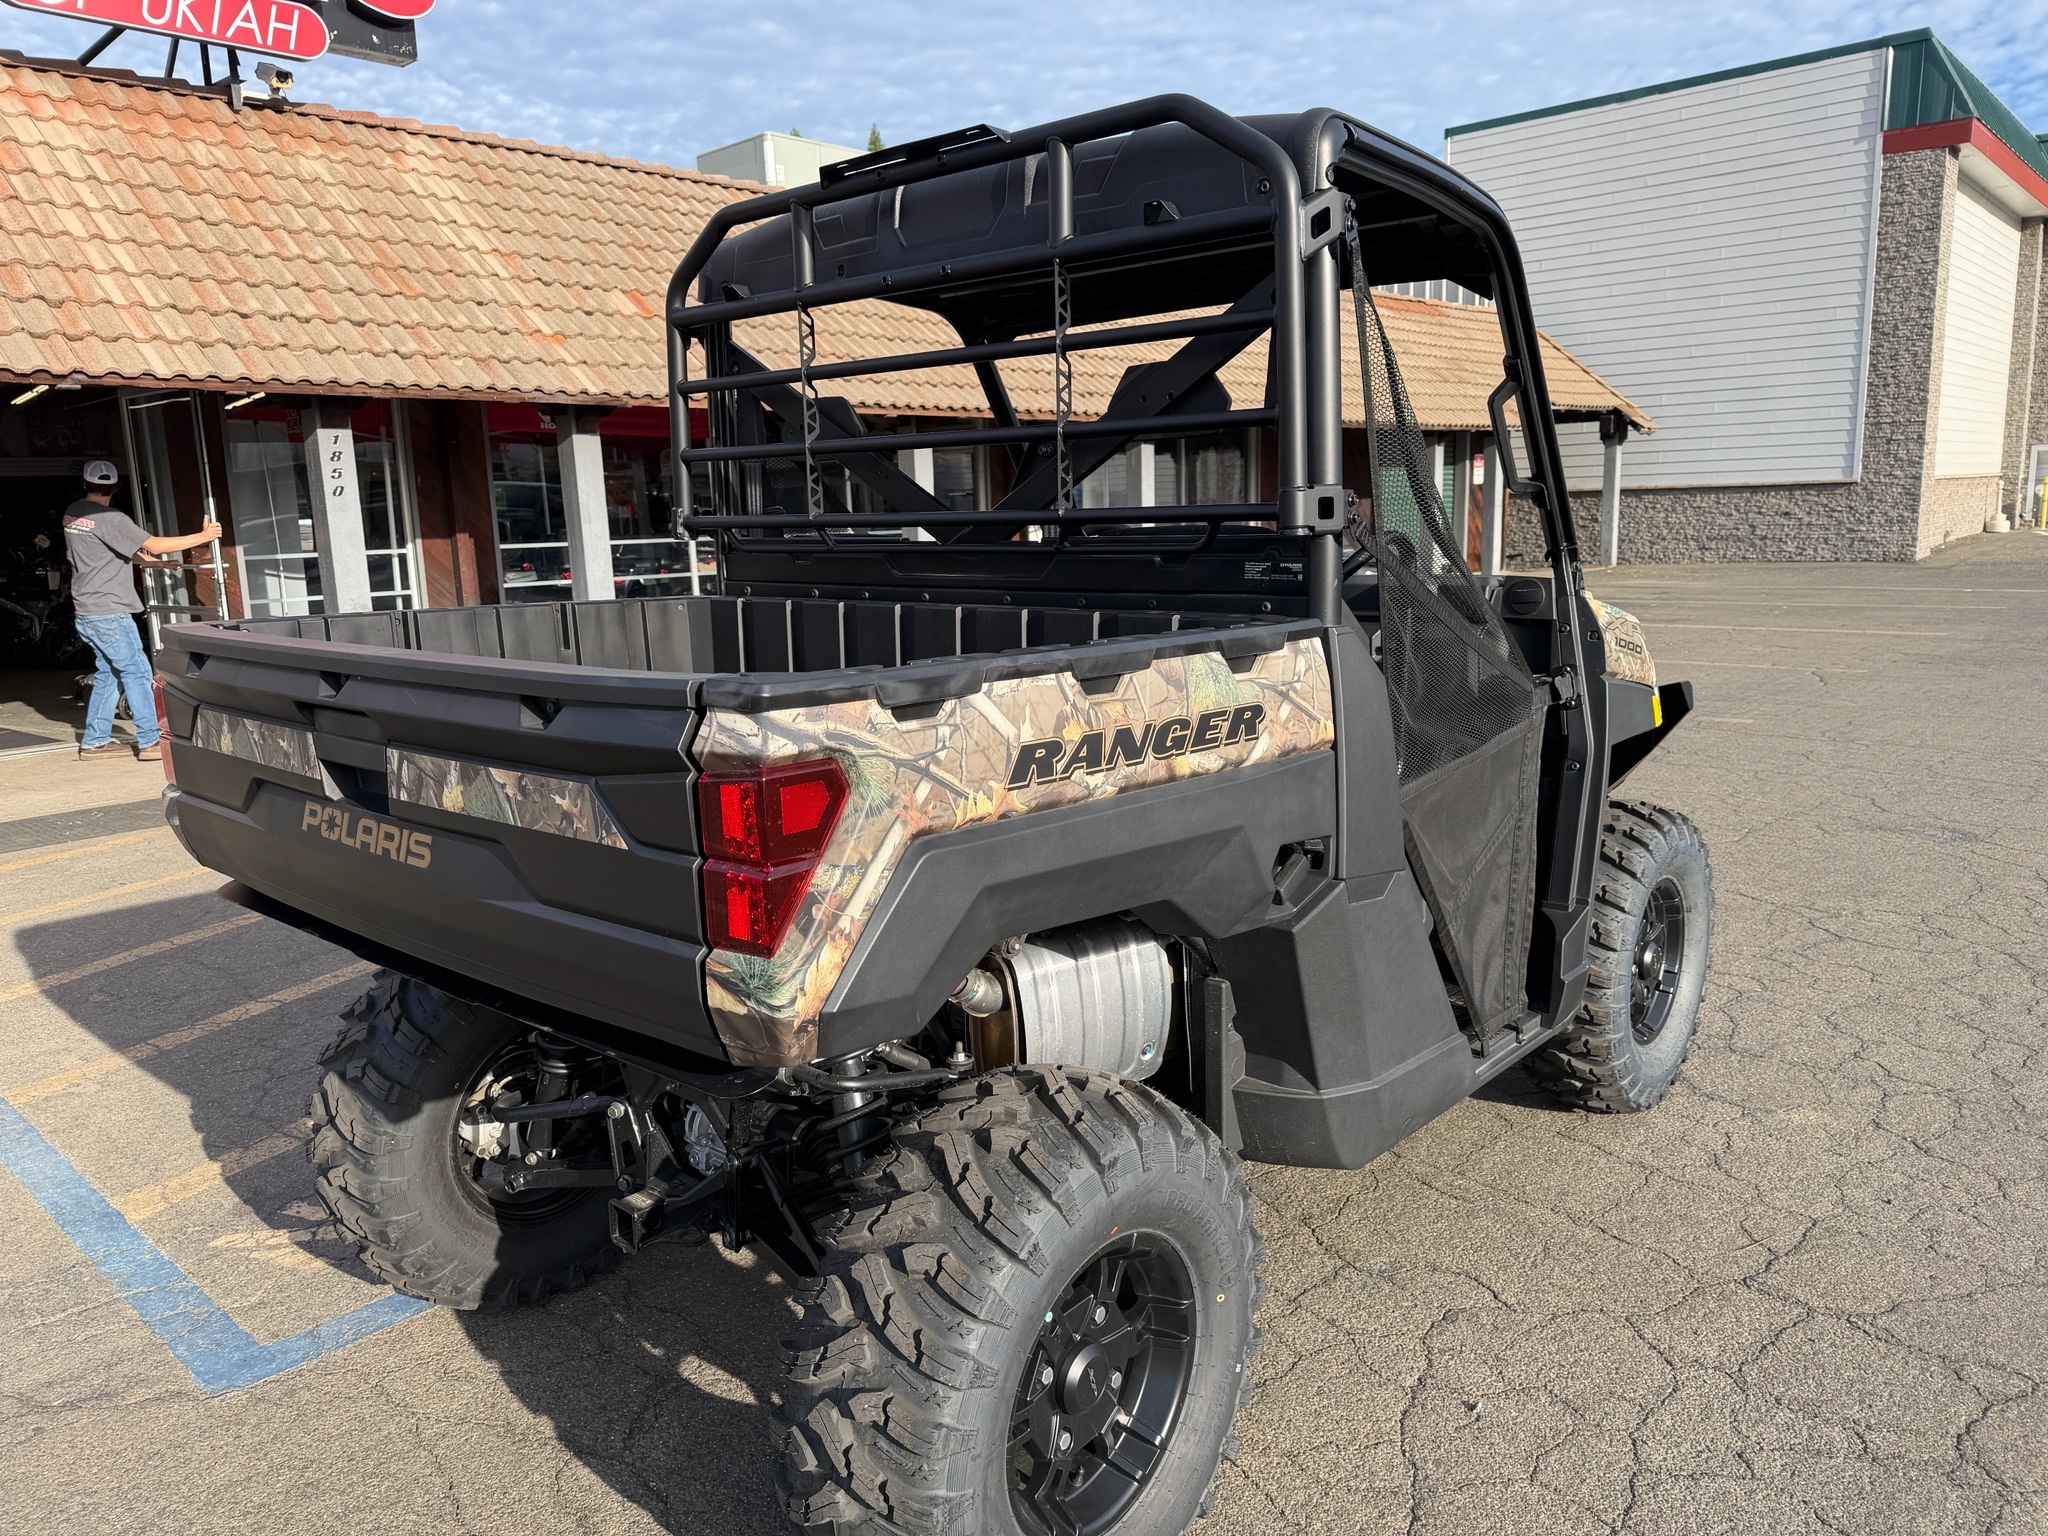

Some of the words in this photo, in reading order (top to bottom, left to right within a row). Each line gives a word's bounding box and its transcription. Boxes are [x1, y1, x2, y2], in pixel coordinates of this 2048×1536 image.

[141, 0, 300, 51] UKIAH
[329, 433, 345, 497] 1850
[1605, 610, 1642, 638] XP
[1614, 636, 1643, 655] 1000
[1004, 701, 1267, 791] RANGER
[301, 800, 433, 869] POLARIS
